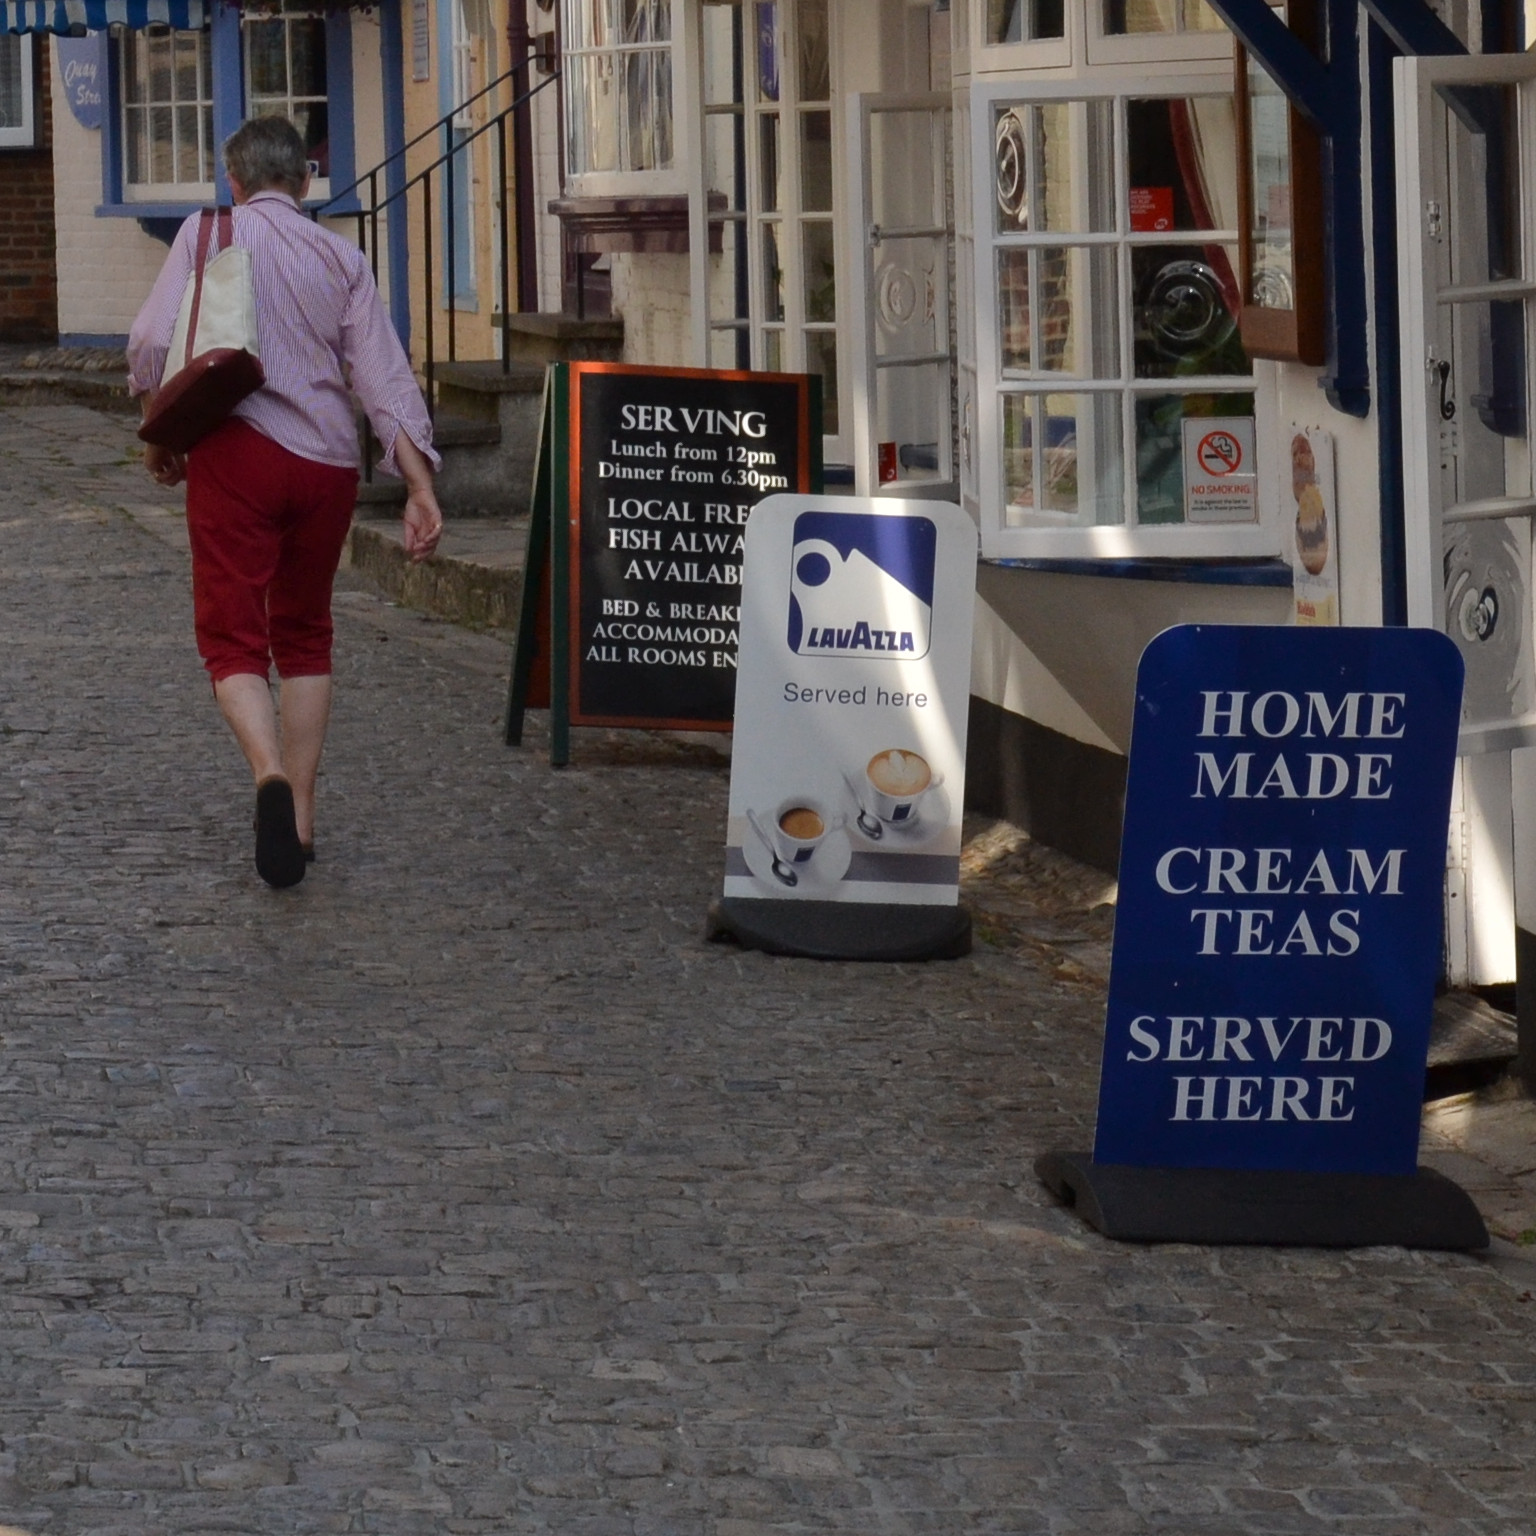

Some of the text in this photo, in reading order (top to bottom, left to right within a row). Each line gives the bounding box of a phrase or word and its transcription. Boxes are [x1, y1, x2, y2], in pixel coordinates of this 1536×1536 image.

[64, 60, 97, 87] Quay
[621, 404, 767, 439] SERVING
[610, 440, 777, 465] Lunch from 12pm
[598, 461, 789, 489] Dinner from 6.30pm
[1192, 484, 1250, 495] NO SMOKING
[607, 497, 756, 525] LOCAL FRE
[608, 527, 661, 550] FISH
[602, 599, 639, 618] BED
[645, 602, 662, 619] &
[807, 621, 915, 652] LAVAZZA
[586, 645, 621, 663] ALL
[627, 648, 706, 666] ROOMS
[783, 682, 929, 708] Served here
[1196, 690, 1407, 739] HOME
[1190, 752, 1394, 800] MADE
[1155, 846, 1408, 896] CREAM
[1190, 909, 1361, 957] TEAS
[1126, 1015, 1394, 1063] SERVED
[1168, 1075, 1356, 1122] HERE
